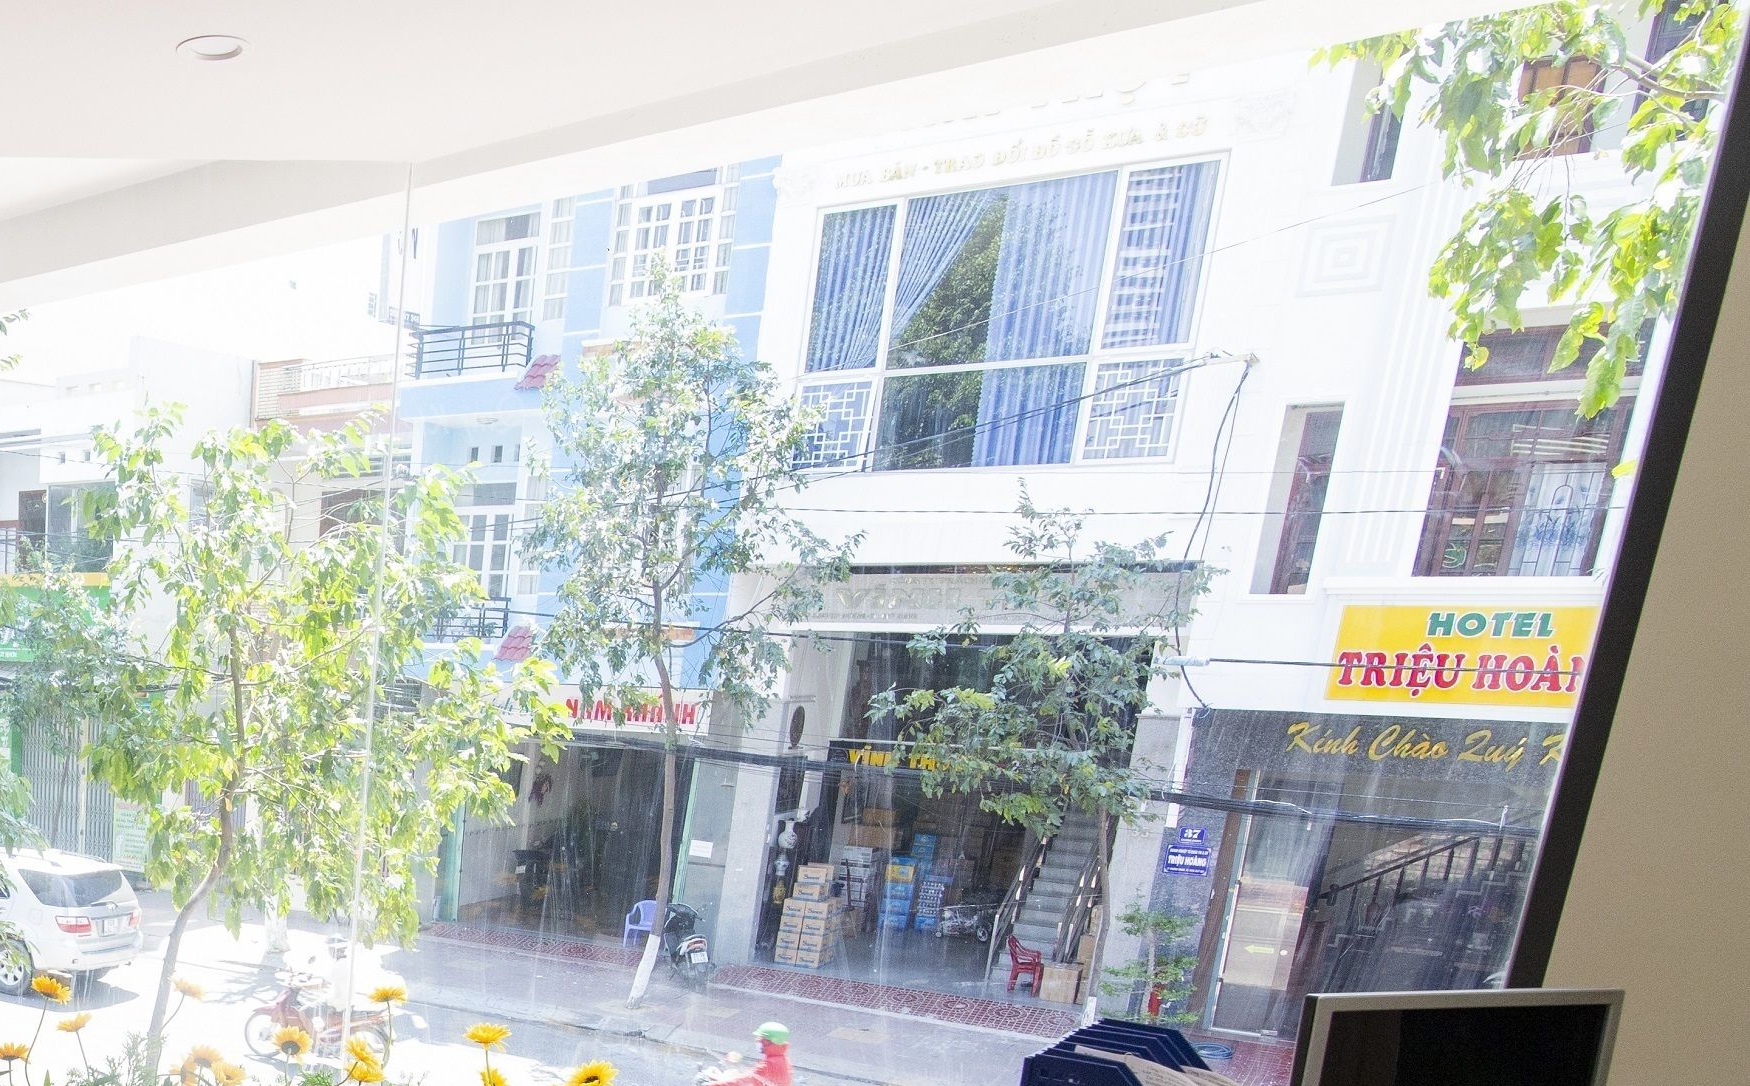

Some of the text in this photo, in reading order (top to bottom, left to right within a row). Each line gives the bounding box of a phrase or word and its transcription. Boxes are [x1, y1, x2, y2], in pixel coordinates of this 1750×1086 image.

[1426, 612, 1554, 638] HOTEL
[1337, 642, 1467, 698] TRIỆU
[1286, 721, 1362, 756] Kính
[1367, 724, 1449, 762] Chào
[1457, 729, 1528, 773] Quý
